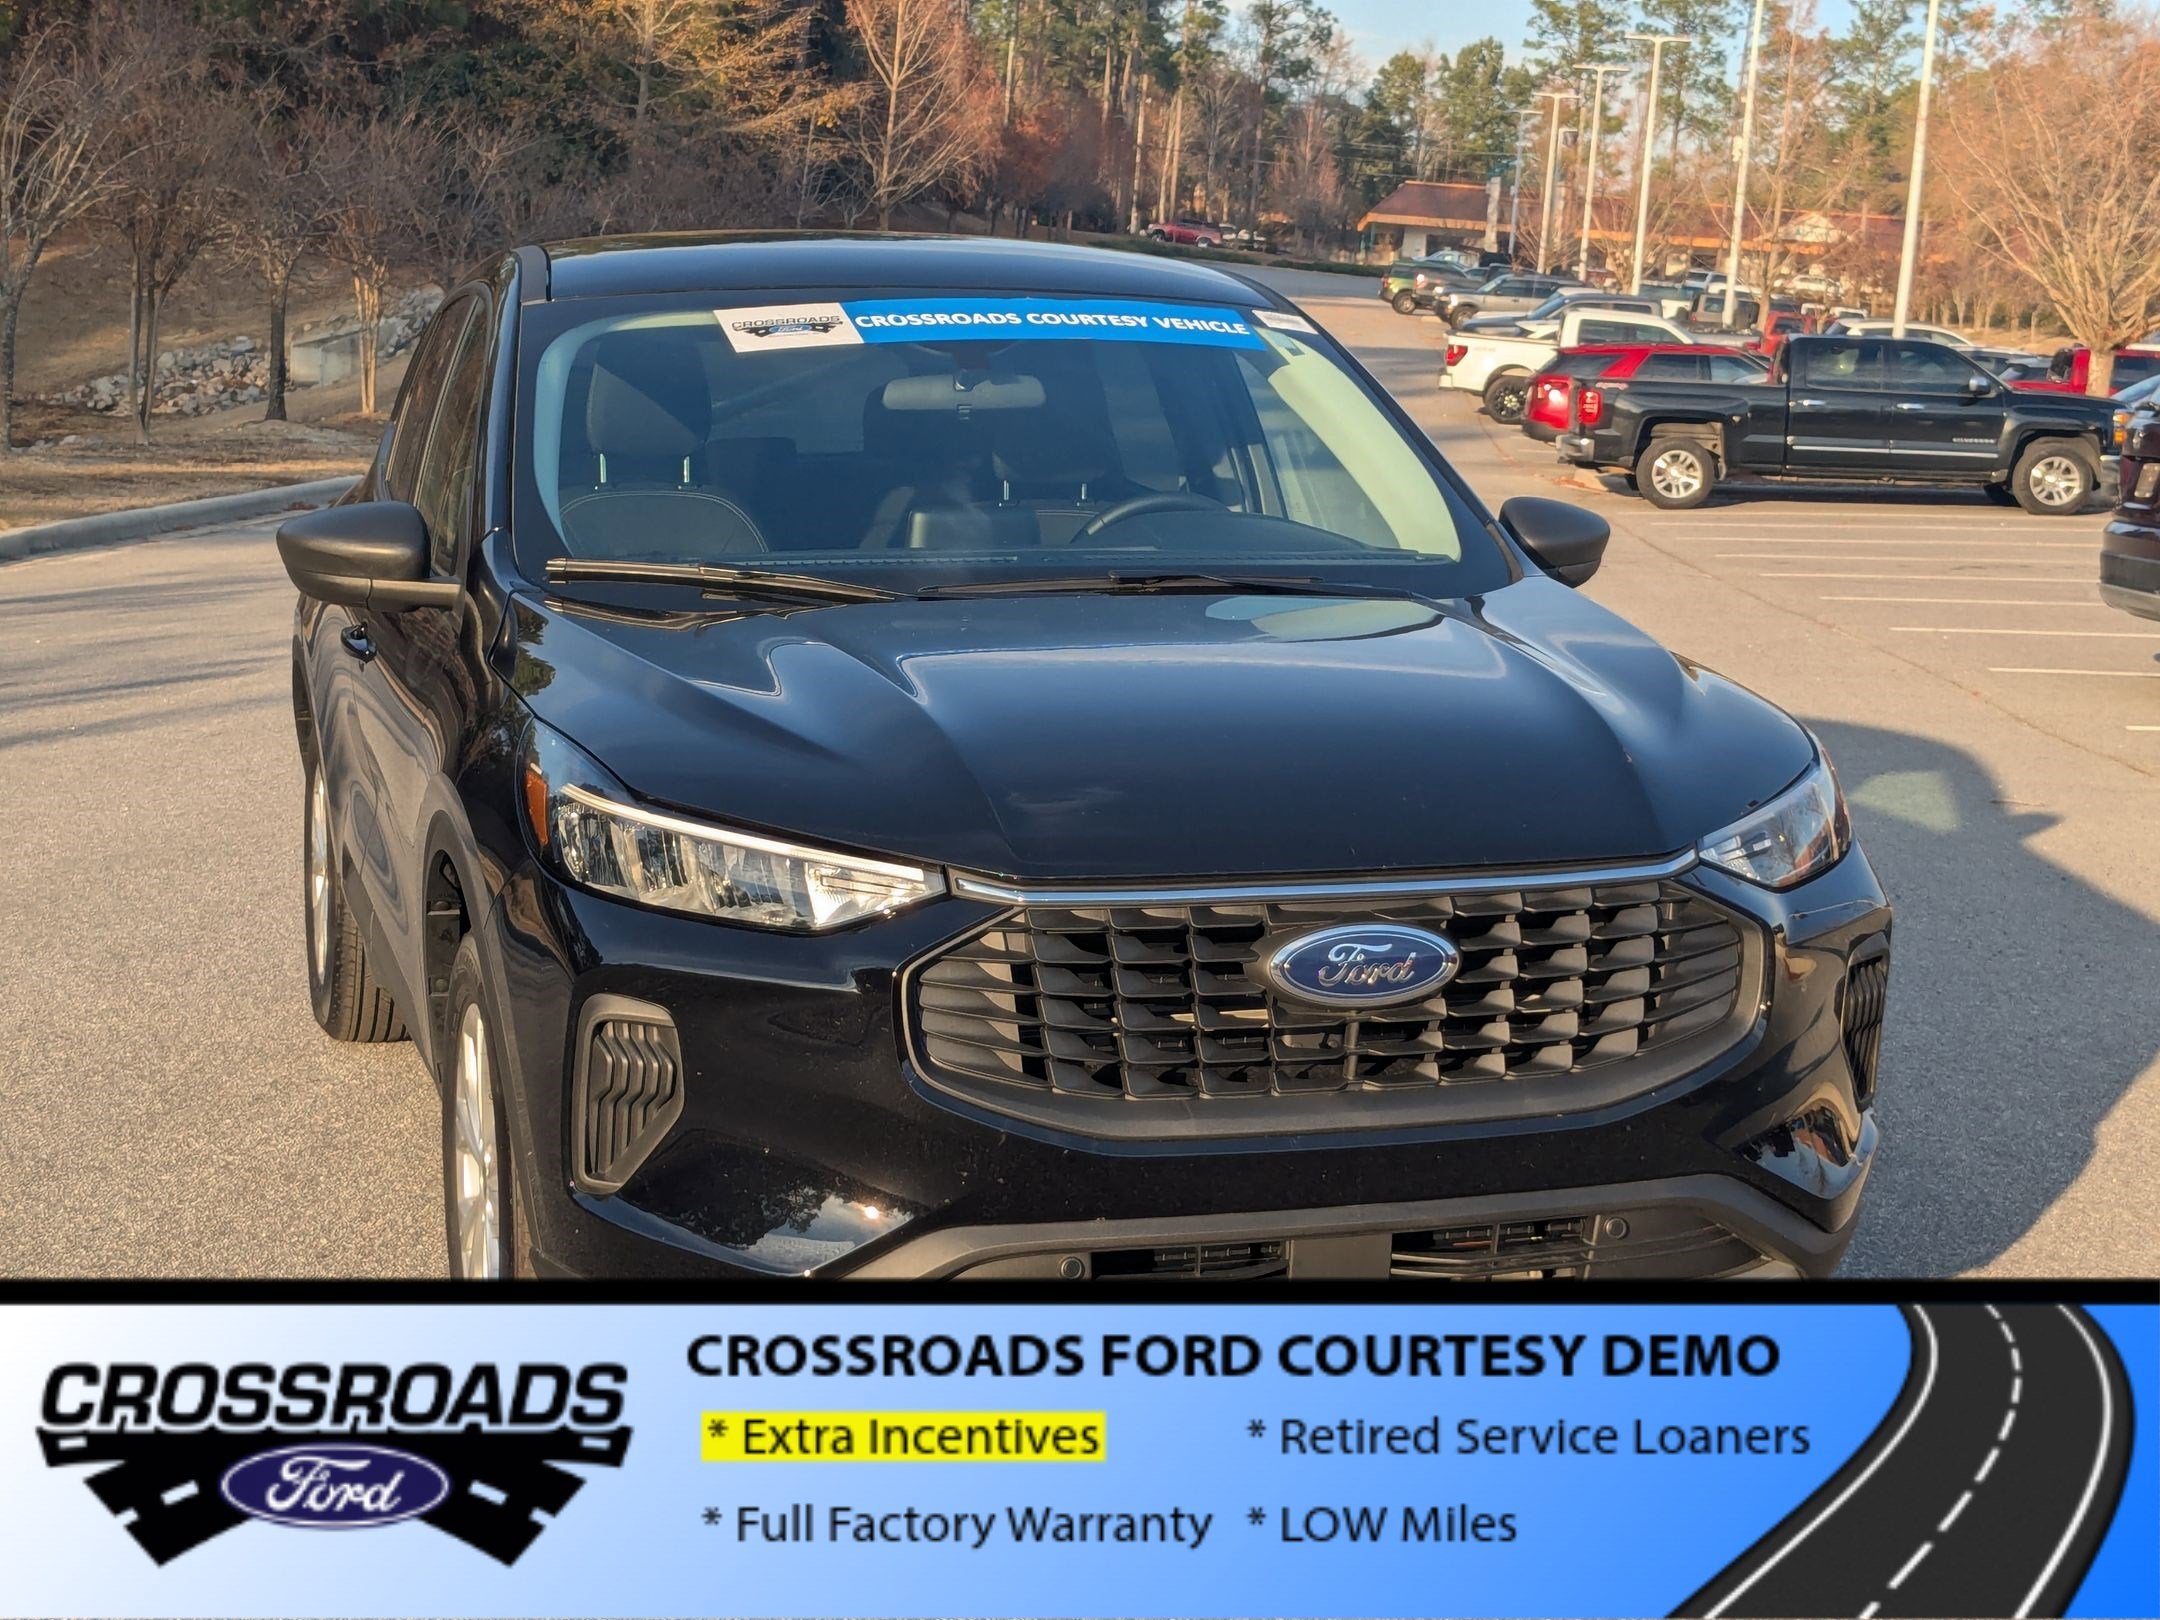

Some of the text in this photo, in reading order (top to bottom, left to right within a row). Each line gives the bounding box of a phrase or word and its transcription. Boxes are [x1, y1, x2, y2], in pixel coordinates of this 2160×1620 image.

[731, 315, 841, 330] CROSSROADS
[854, 312, 1023, 328] CROSSROADS
[1026, 312, 1149, 328] COURTESY
[1151, 316, 1250, 335] VEHICLE
[1317, 943, 1417, 988] Ford
